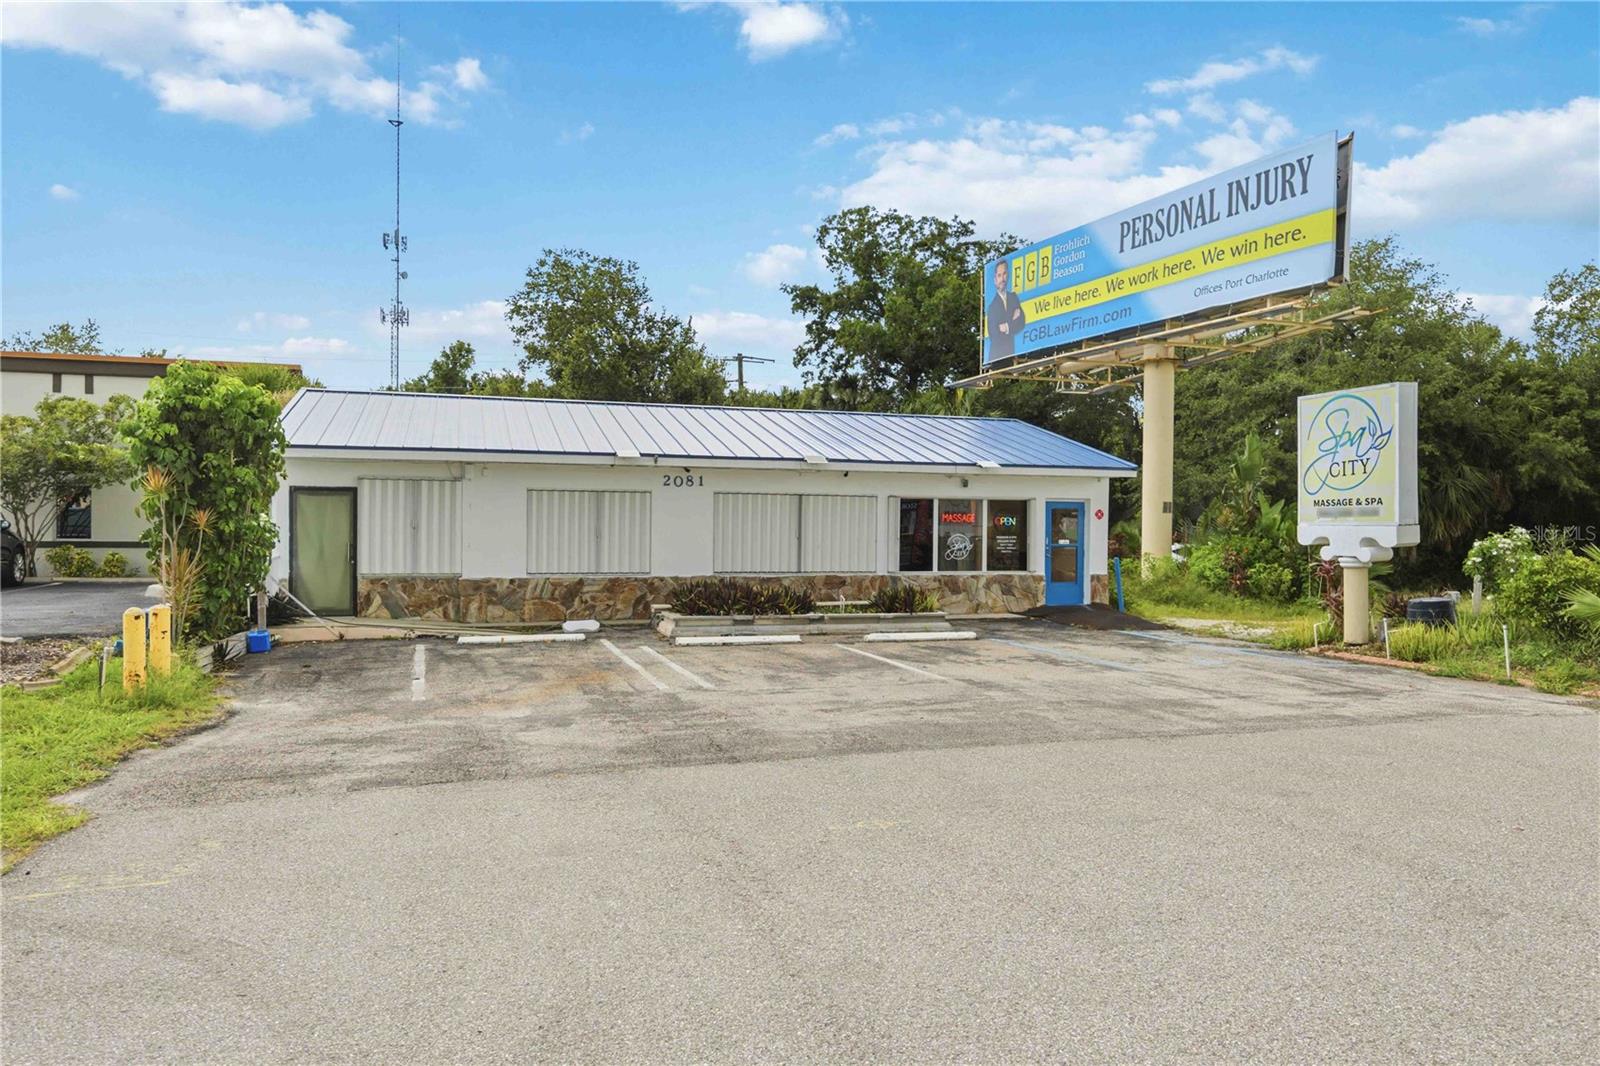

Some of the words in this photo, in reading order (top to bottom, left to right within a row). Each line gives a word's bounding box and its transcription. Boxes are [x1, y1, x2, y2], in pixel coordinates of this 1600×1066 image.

[1119, 188, 1220, 253] PERSONAL
[1226, 154, 1314, 218] INJURY
[1054, 234, 1090, 255] Frohlich
[1053, 249, 1086, 266] Gordon
[1034, 301, 1050, 314] We
[1053, 294, 1072, 309] live
[1074, 287, 1102, 304] here.
[1106, 278, 1125, 294] We
[1128, 267, 1159, 286] work
[1162, 259, 1196, 278] here.
[1201, 246, 1225, 266] We
[1230, 239, 1258, 258] win
[1264, 228, 1306, 249] here.
[1053, 262, 1084, 280] Beason
[1193, 283, 1223, 298] Offices
[1225, 279, 1243, 290] Port
[1246, 267, 1289, 285] Charlotte
[1022, 306, 1132, 345] FGBLawFirm.com
[1329, 457, 1370, 478] CITY
[663, 474, 703, 488] 2081
[1313, 498, 1353, 508] MASSAGE
[1355, 498, 1362, 506] &
[1364, 497, 1383, 506] SPA
[942, 512, 976, 523] MASSAGE
[993, 516, 1016, 526] OPEN
